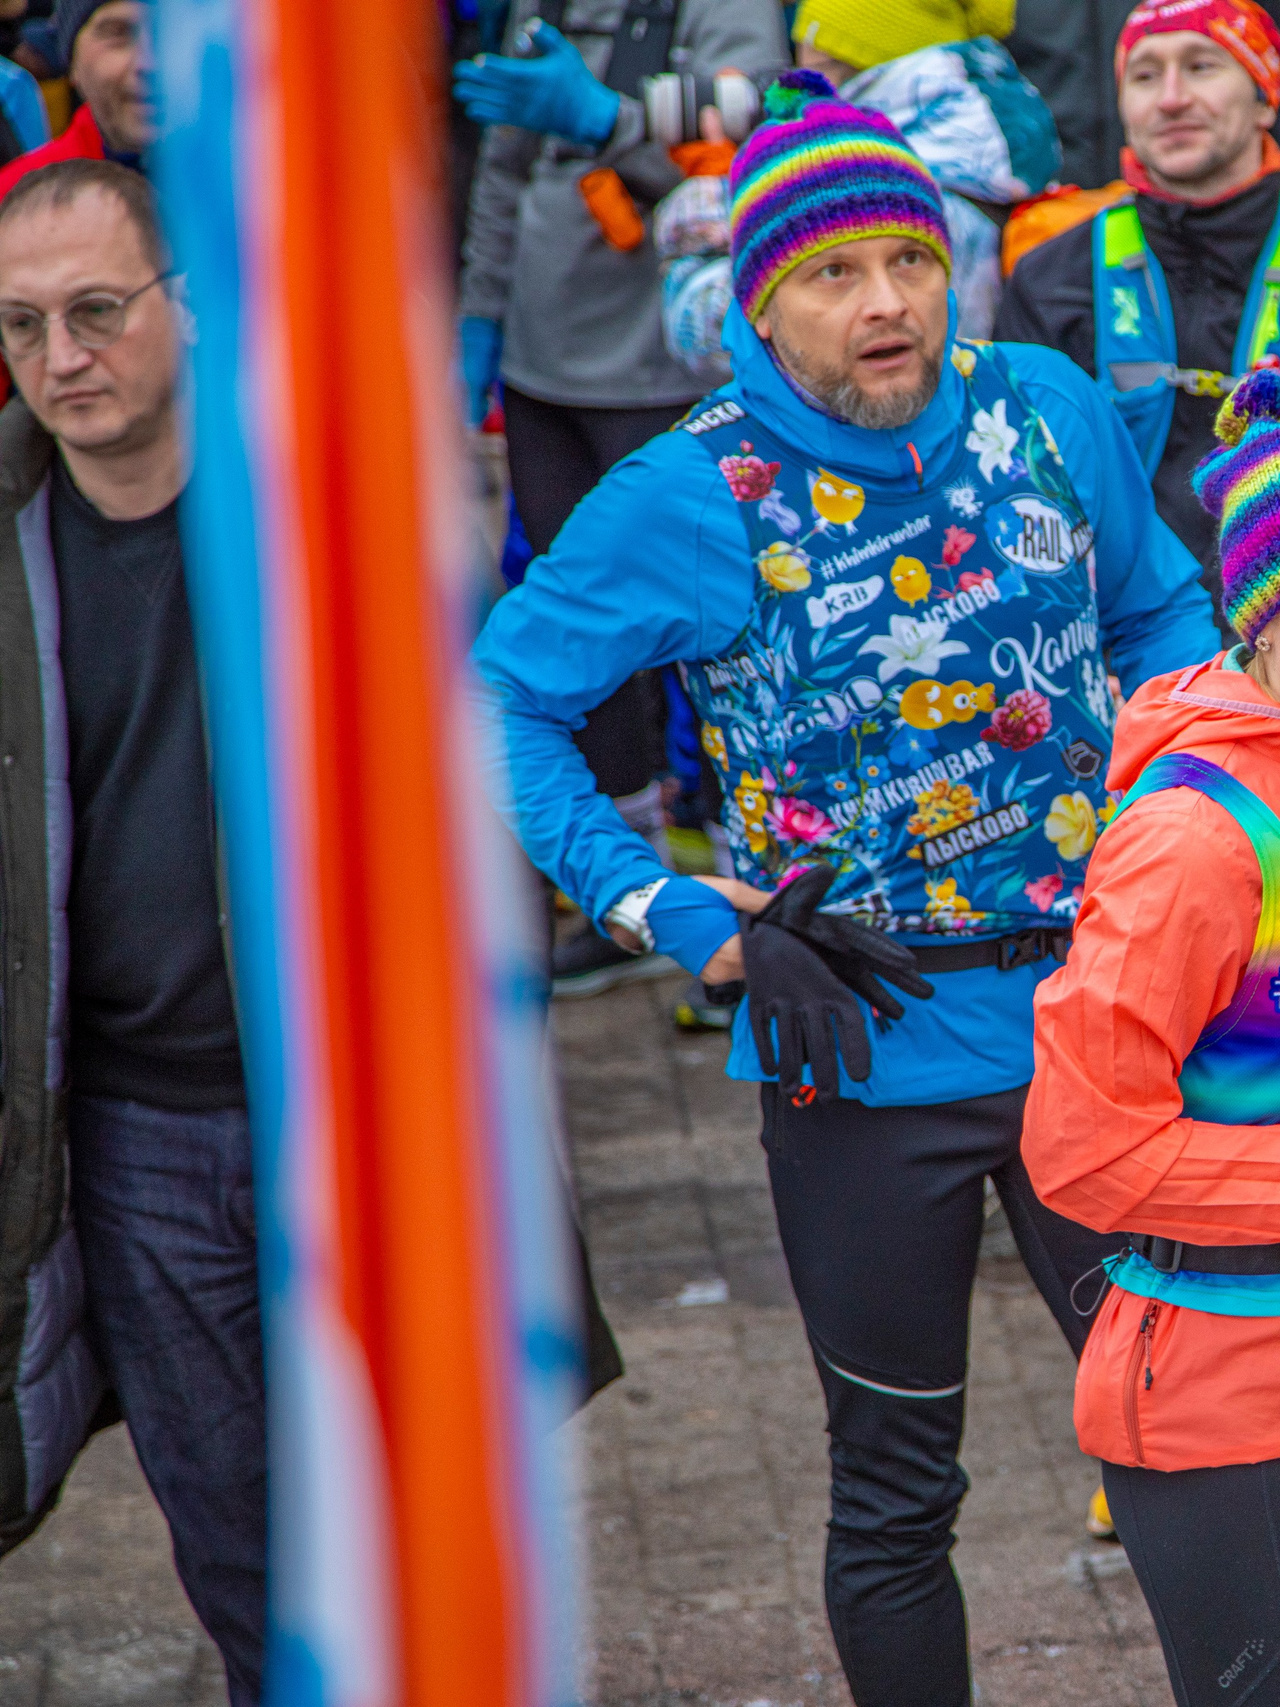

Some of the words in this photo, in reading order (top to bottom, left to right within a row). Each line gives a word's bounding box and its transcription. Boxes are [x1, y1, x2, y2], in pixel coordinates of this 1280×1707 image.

[683, 401, 746, 435] ЫСКО
[923, 804, 1029, 867] ЛЫСКОВО
[1218, 1648, 1253, 1689] CRAFT
